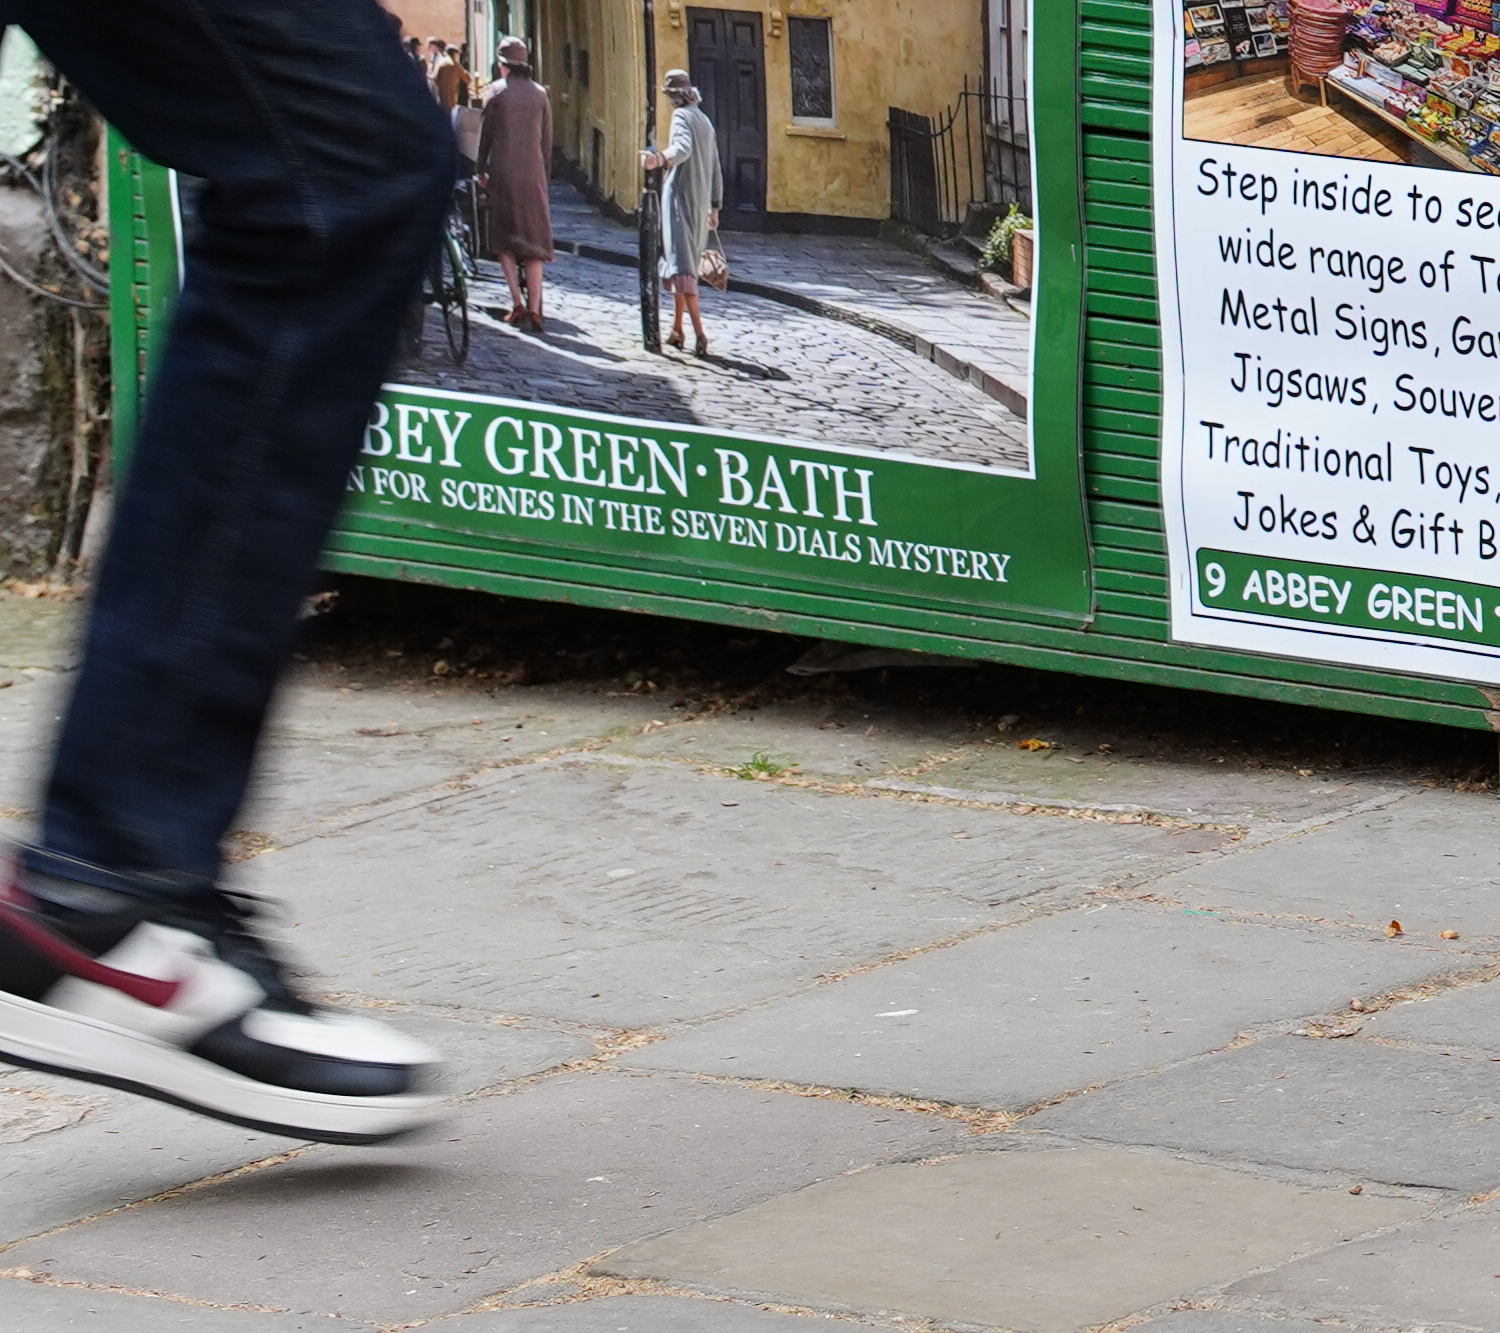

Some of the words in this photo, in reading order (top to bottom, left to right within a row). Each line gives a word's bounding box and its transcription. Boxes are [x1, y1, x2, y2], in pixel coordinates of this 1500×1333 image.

[1198, 158, 1278, 215] Step
[1292, 166, 1393, 217] inside
[1408, 185, 1443, 224] to
[1218, 229, 1297, 270] wide
[1310, 244, 1406, 293] range
[1419, 250, 1454, 292] of
[1220, 287, 1318, 336] Metal
[1335, 303, 1440, 358] Signs,
[1231, 352, 1378, 414] Jigsaws,
[361, 402, 472, 467] BEY
[1200, 420, 1393, 482] Traditional
[1409, 446, 1500, 504] Toys,
[373, 466, 431, 503] FOR
[441, 479, 555, 522] SCENES
[562, 493, 595, 527] IN
[600, 497, 665, 536] THE
[671, 506, 769, 549] SEVEN
[776, 525, 861, 565] DIALS
[868, 536, 1011, 585] MYSTERY
[1233, 490, 1338, 541] Jokes
[1353, 506, 1376, 545] &
[1391, 508, 1464, 555] Gift
[1205, 562, 1226, 597] 9
[1243, 569, 1351, 615] ABBEY
[1368, 583, 1483, 632] GREEN
